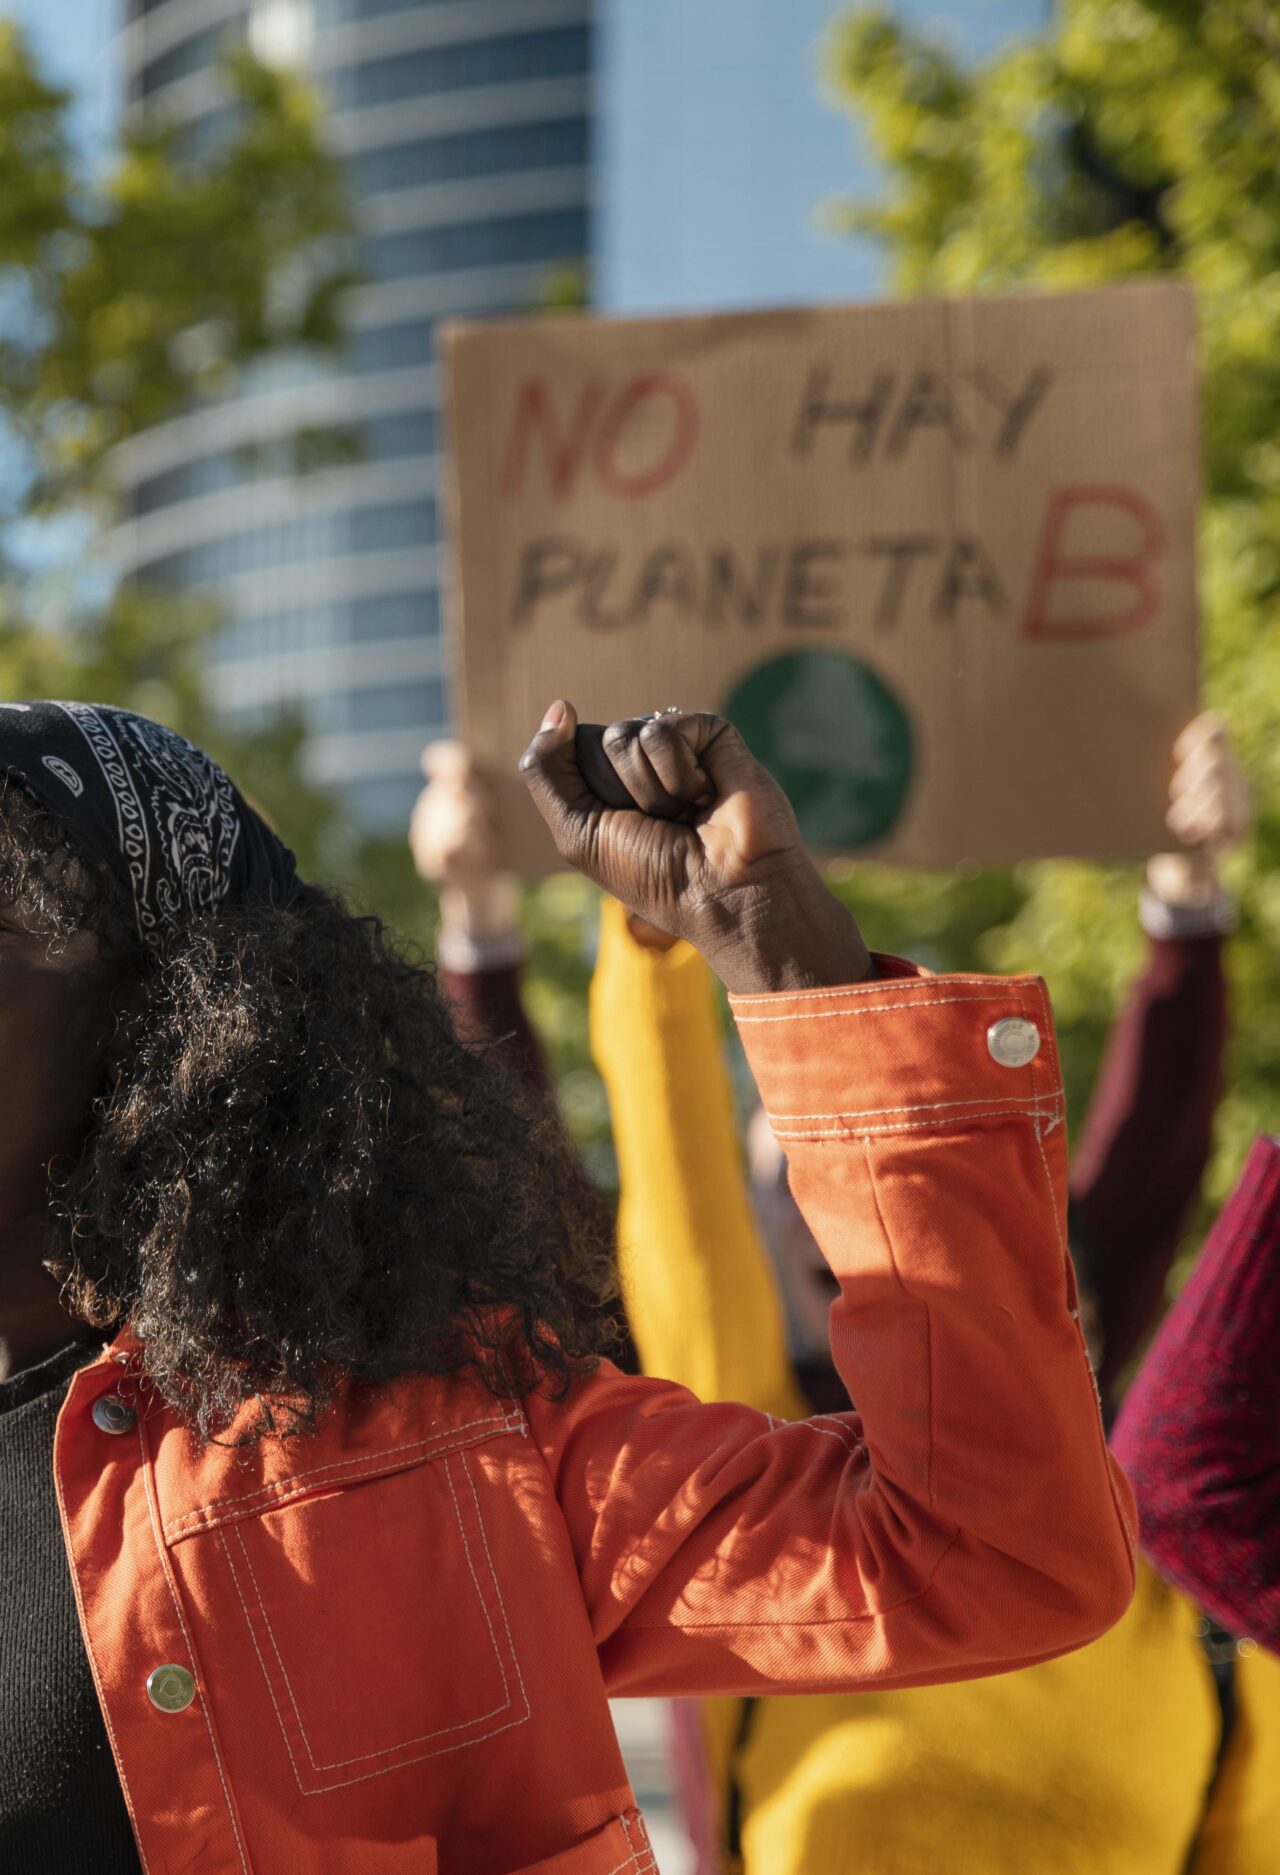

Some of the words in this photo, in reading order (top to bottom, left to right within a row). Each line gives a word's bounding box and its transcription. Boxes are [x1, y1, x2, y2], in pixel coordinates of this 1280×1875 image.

[501, 373, 700, 500] NO
[790, 364, 1052, 466] HAY
[512, 536, 1008, 634] PLANETA
[1024, 484, 1166, 641] B
